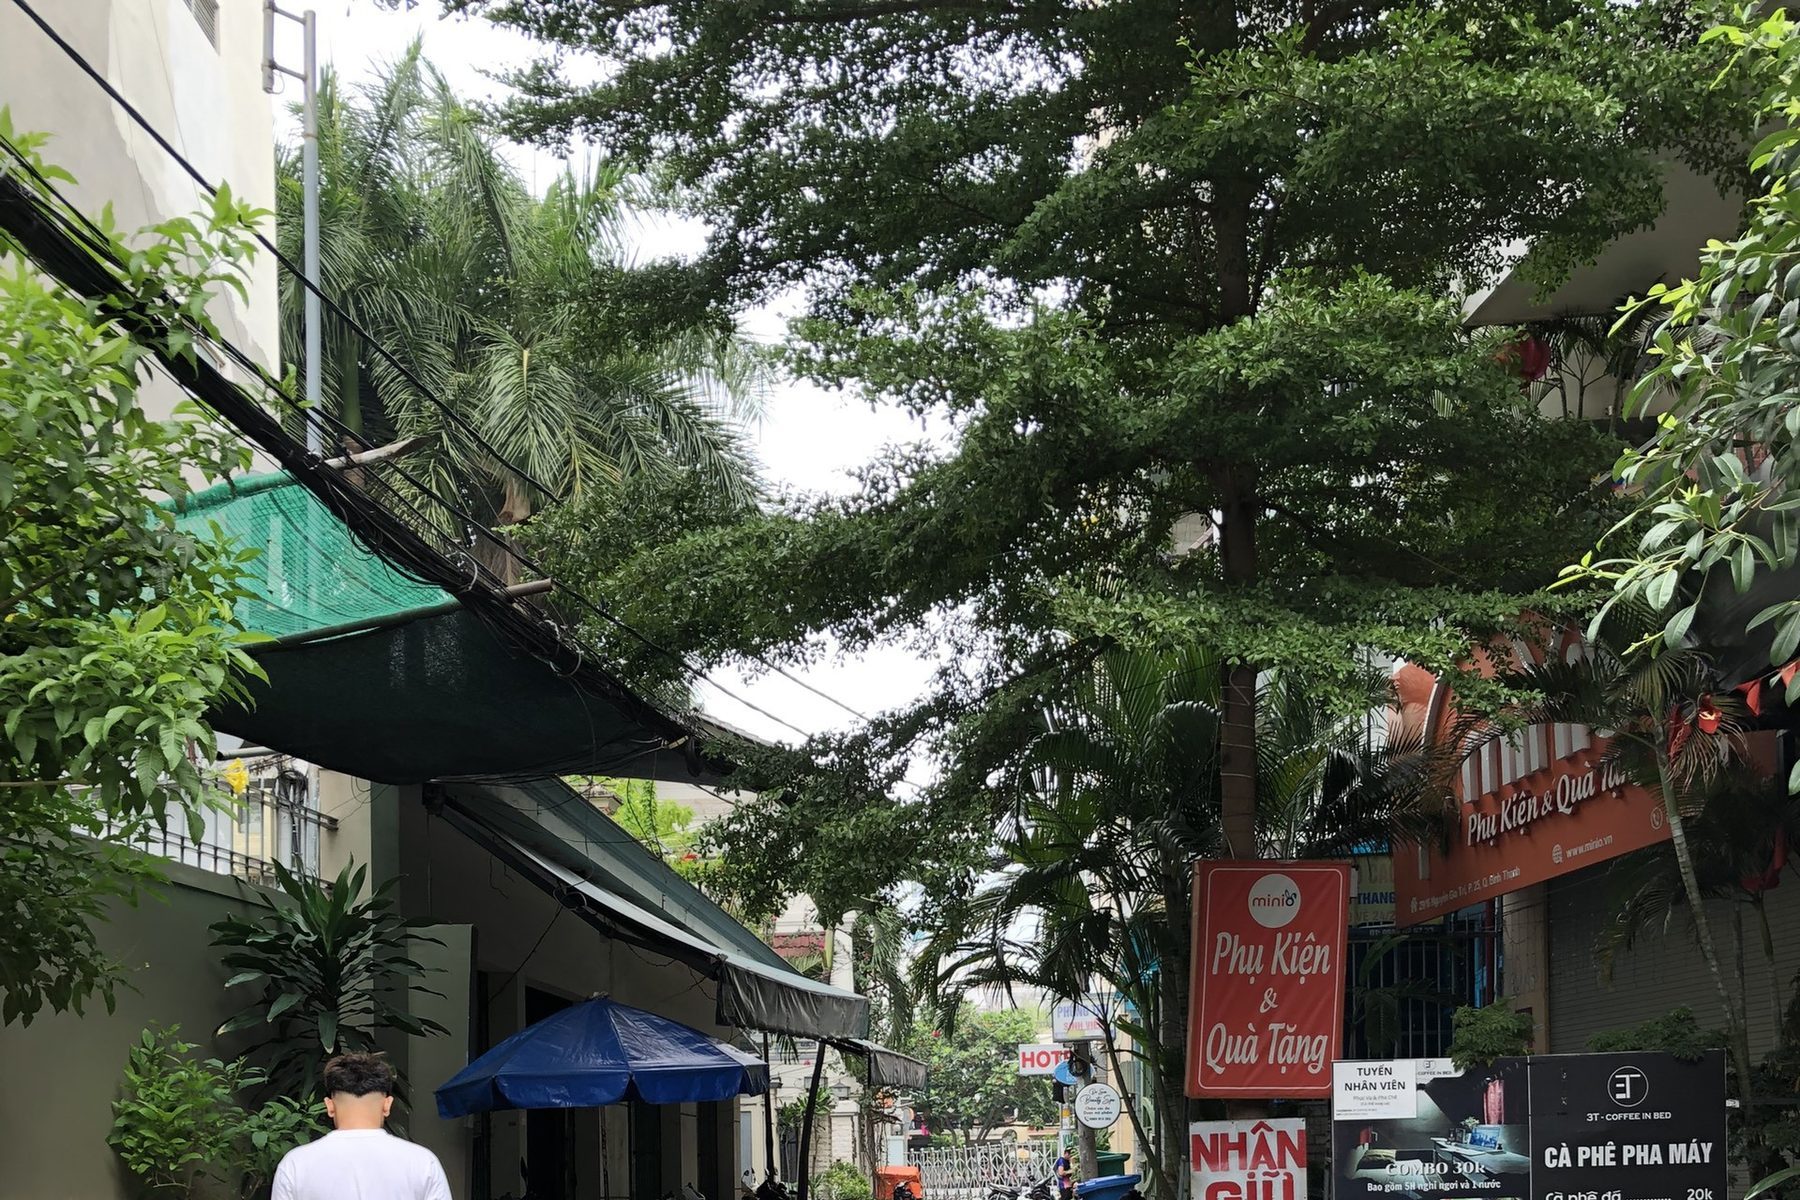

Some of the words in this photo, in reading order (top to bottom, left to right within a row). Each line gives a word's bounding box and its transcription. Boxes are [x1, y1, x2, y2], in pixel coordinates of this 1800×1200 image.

[1467, 813, 1497, 846] Phụ
[1500, 791, 1540, 835] Kiện
[1541, 793, 1553, 817] &
[1556, 761, 1595, 815] Quà
[1212, 932, 1263, 984] Phụ
[1271, 932, 1331, 984] Kiện
[1259, 987, 1278, 1013] &
[1206, 1022, 1258, 1075] Quà
[1268, 1022, 1328, 1075] Tặng
[1344, 1079, 1377, 1092] NHÂN
[1379, 1078, 1406, 1091] VIÊN
[1586, 1113, 1600, 1122] 3T
[1605, 1112, 1641, 1121] COFFEE
[1642, 1112, 1652, 1120] IN
[1653, 1111, 1672, 1120] BED
[1544, 1142, 1572, 1169] CÀ
[1577, 1141, 1617, 1168] PHÊ
[1622, 1144, 1663, 1166] PHA
[1668, 1138, 1713, 1165] MÁY
[1385, 1161, 1449, 1176] COMBO
[1367, 1182, 1383, 1192] Bao
[1384, 1181, 1403, 1193] gồm
[1459, 1179, 1470, 1189] và
[1478, 1178, 1501, 1189] nước
[1686, 1188, 1713, 1200] 20k
